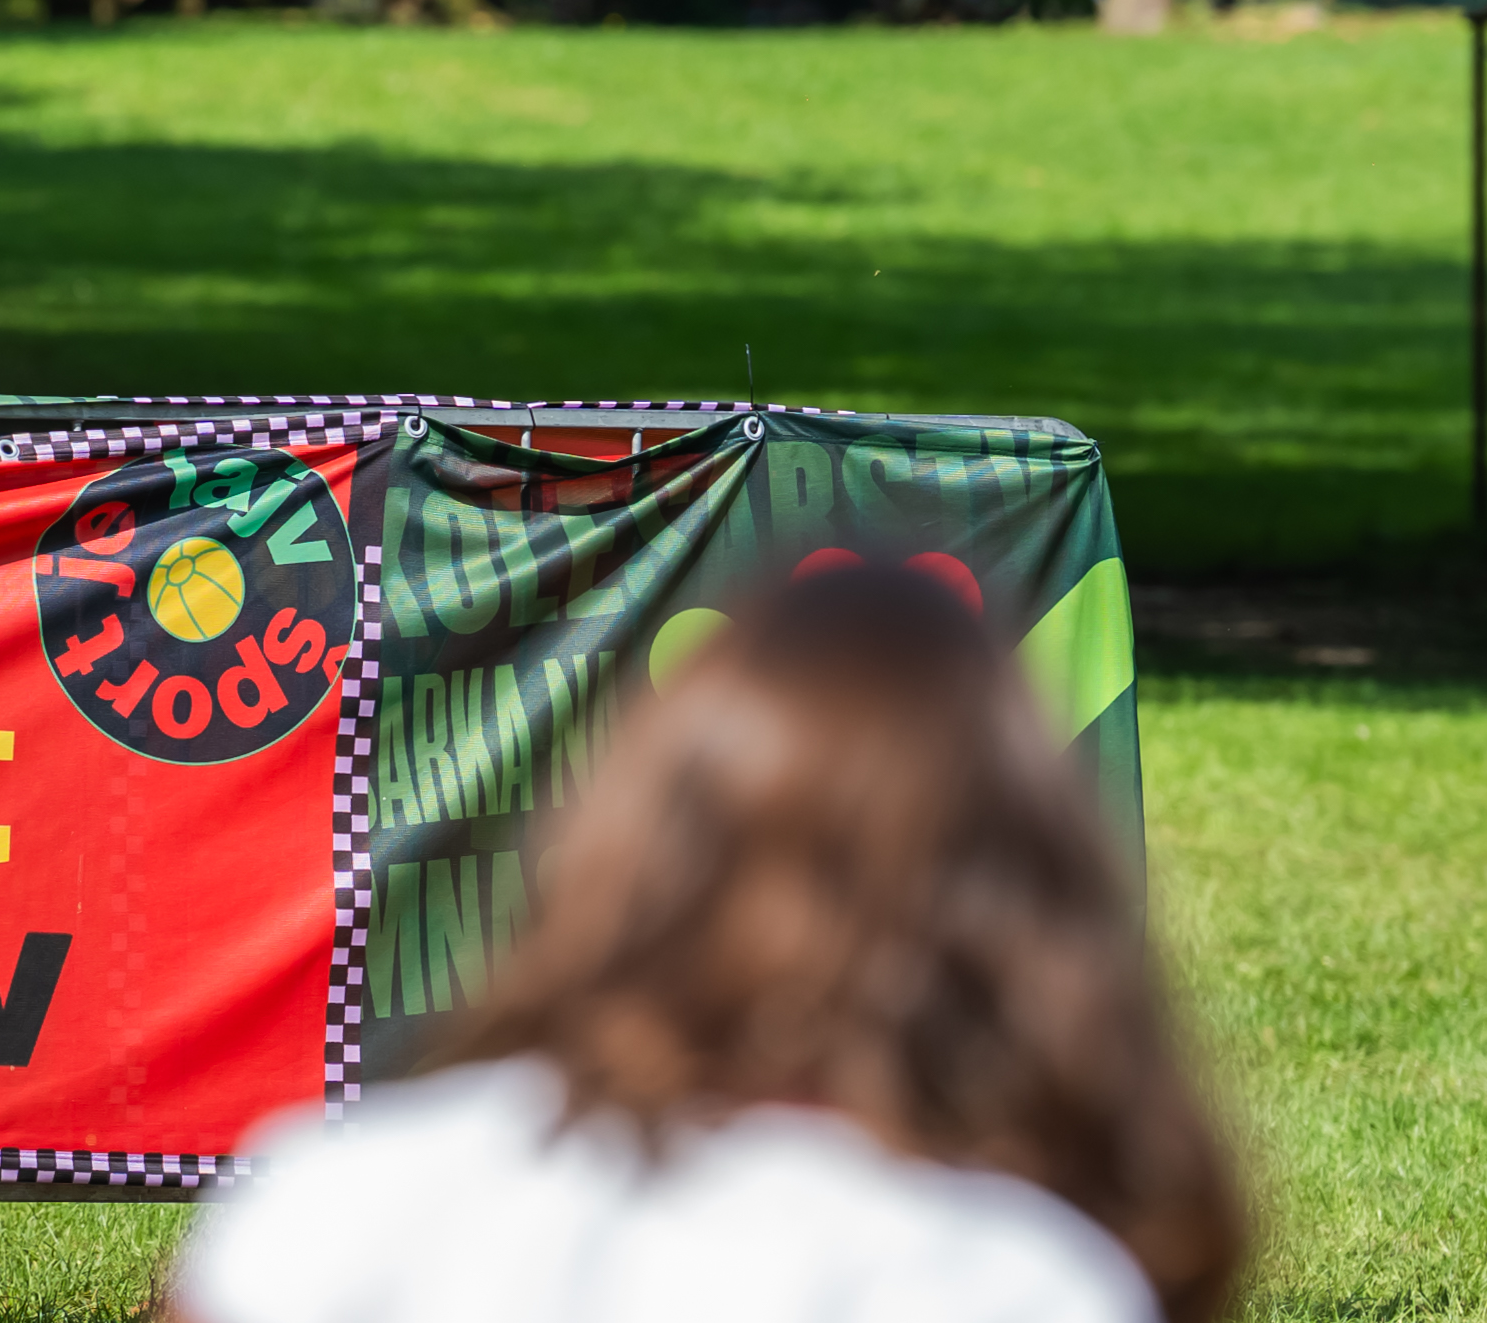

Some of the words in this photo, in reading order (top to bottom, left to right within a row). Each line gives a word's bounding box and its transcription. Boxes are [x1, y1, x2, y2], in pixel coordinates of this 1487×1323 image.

[34, 500, 136, 599] je
[163, 447, 334, 566] lajv
[53, 606, 352, 740] šport
